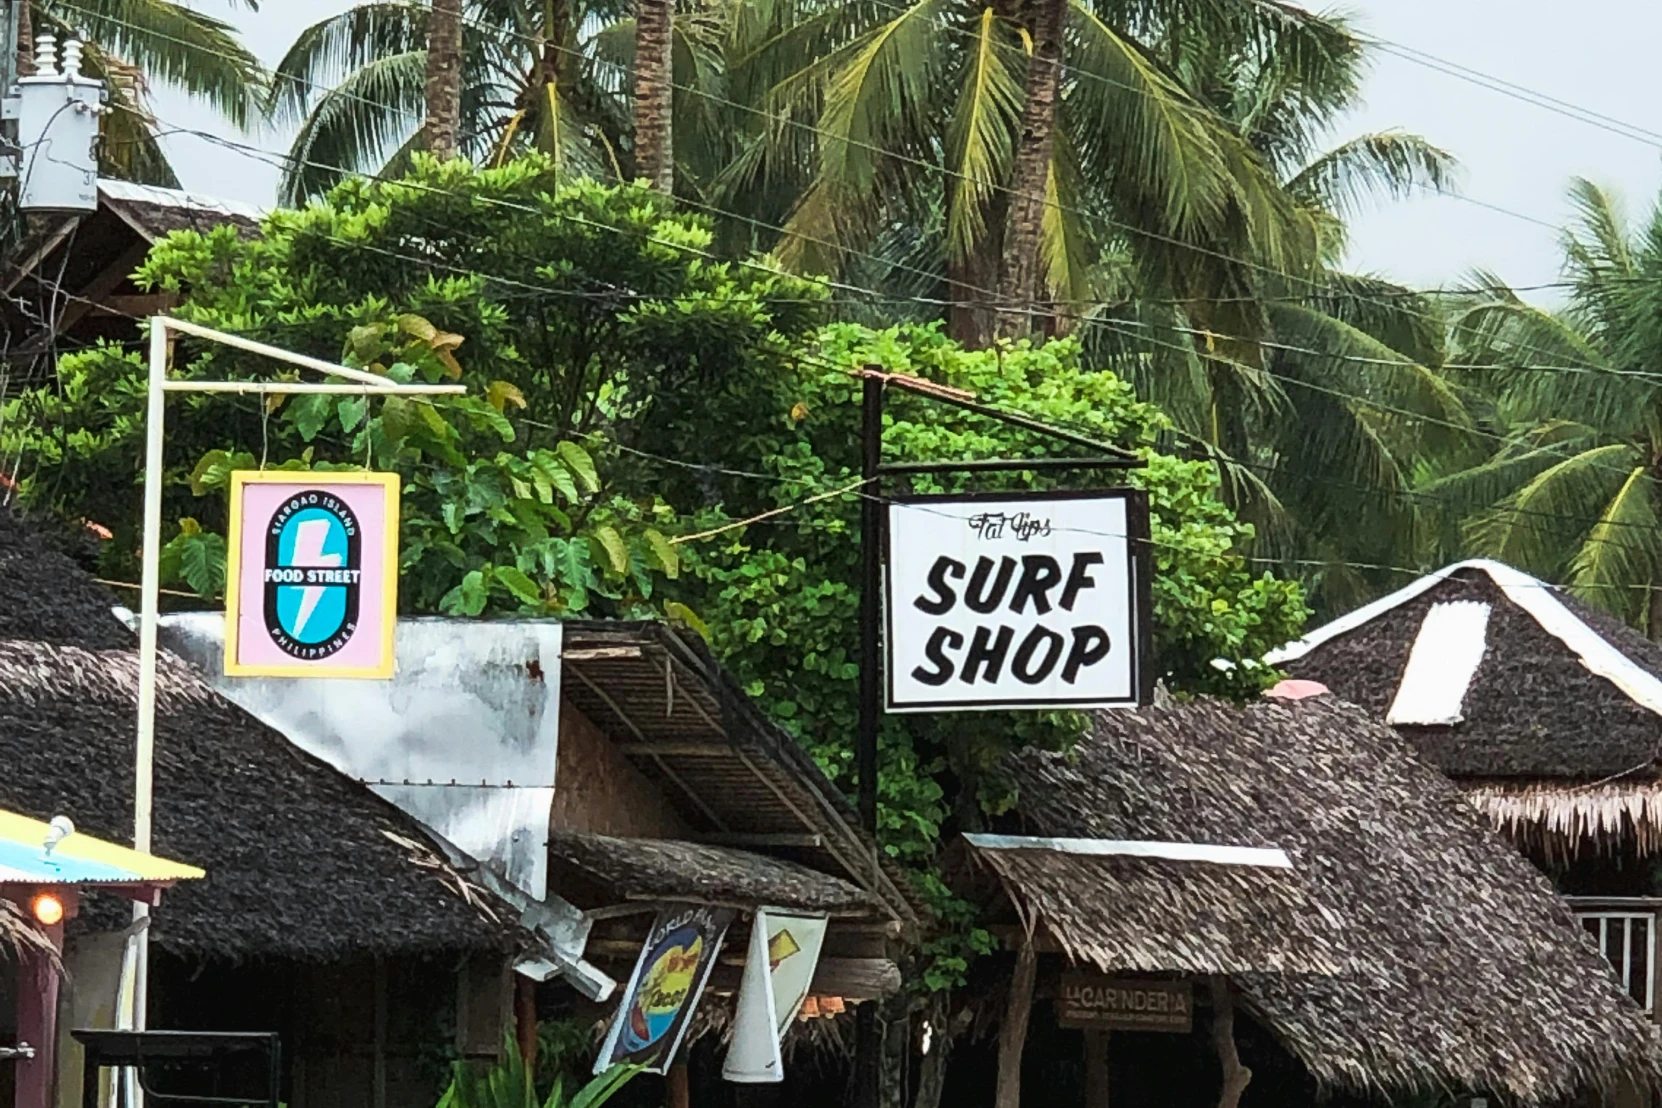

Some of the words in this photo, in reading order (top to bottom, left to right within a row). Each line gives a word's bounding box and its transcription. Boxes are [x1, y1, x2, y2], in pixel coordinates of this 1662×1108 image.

[323, 496, 355, 536] ISLAND
[264, 568, 303, 583] FOOD
[306, 569, 360, 584] STREET
[913, 551, 1104, 616] SURF
[271, 622, 357, 659] PHILIPPINES
[910, 623, 1111, 686] SHOP
